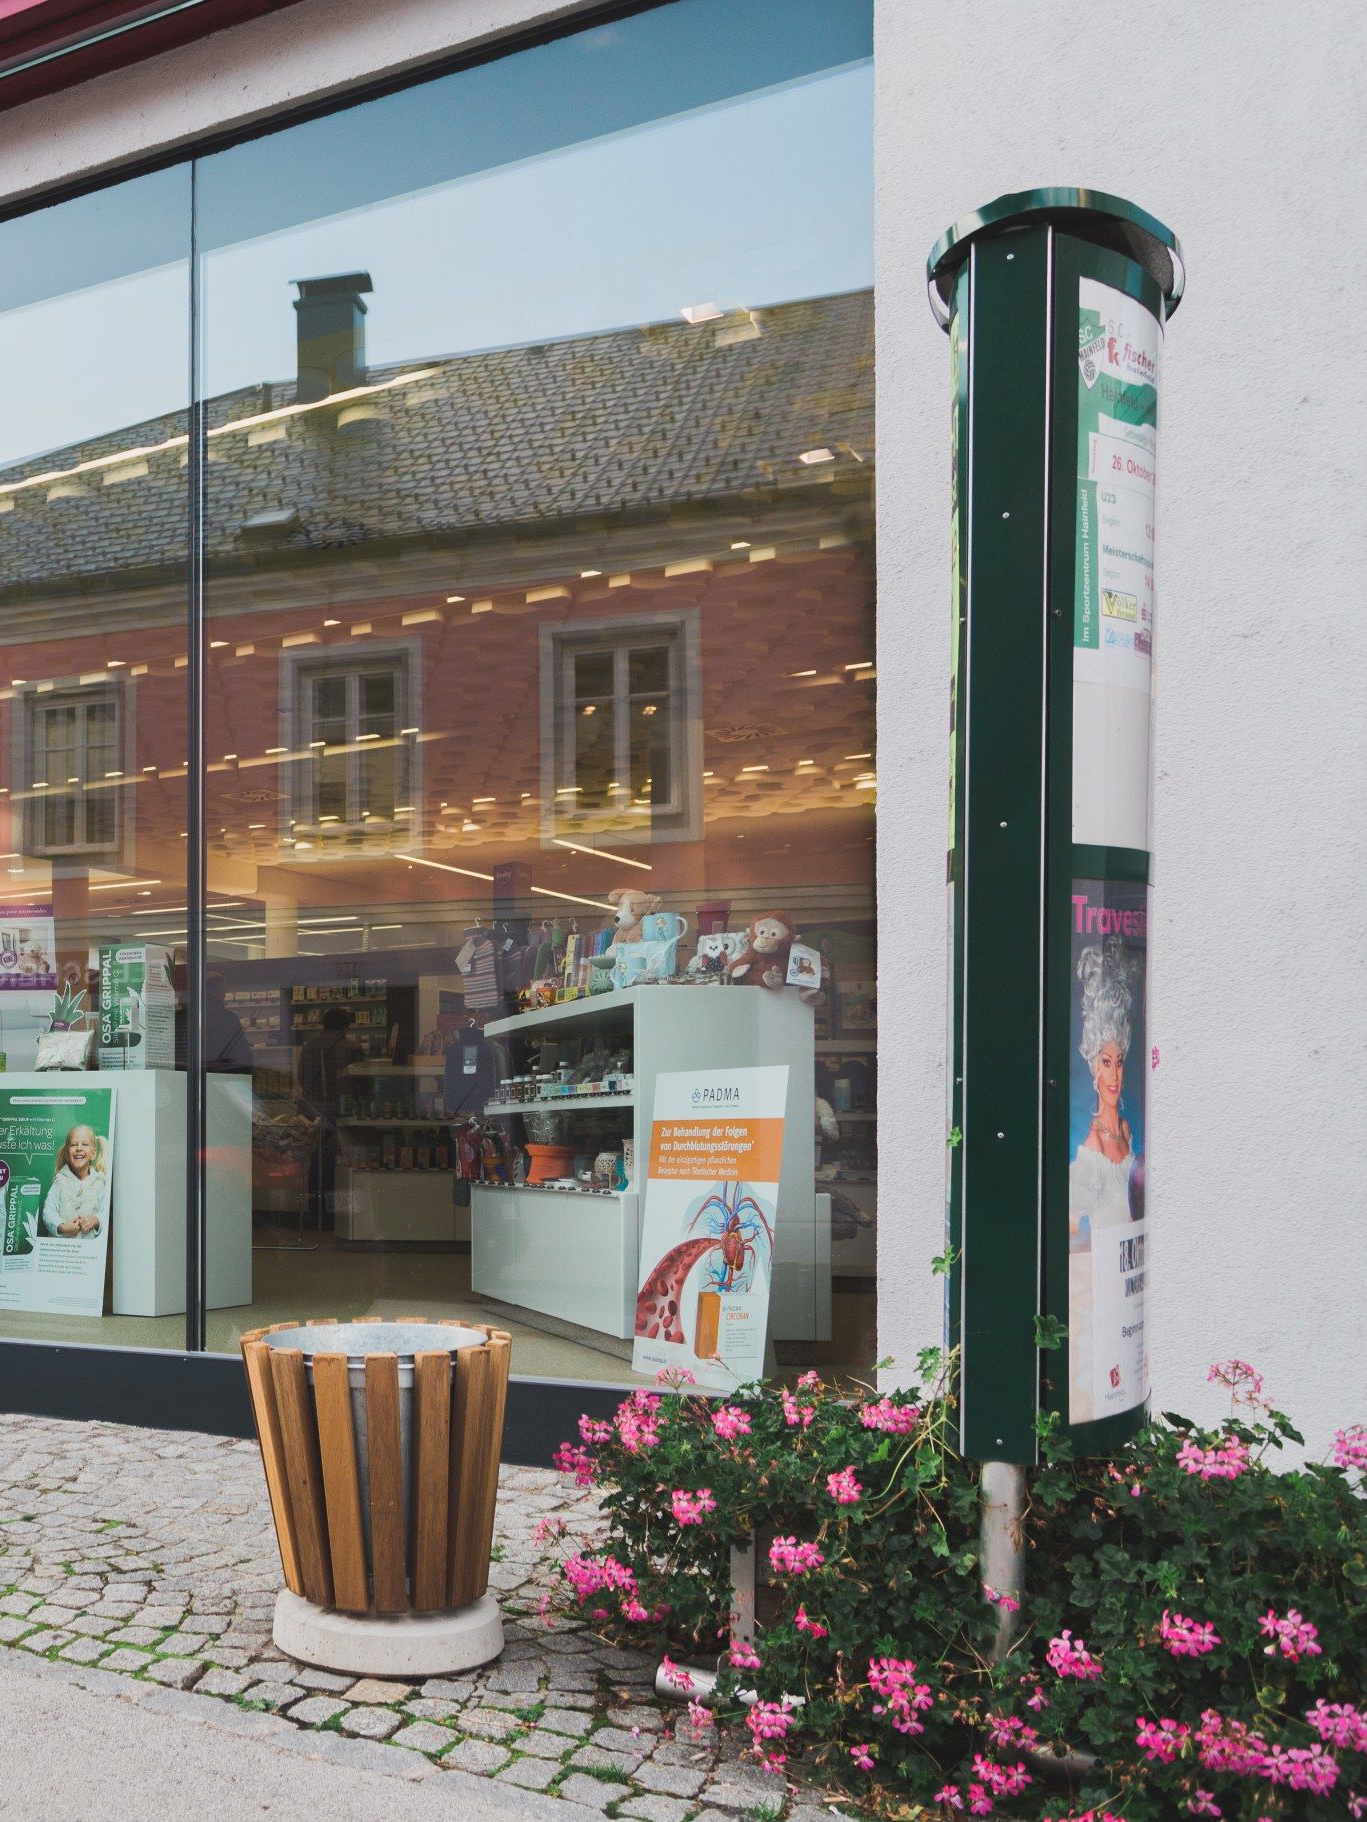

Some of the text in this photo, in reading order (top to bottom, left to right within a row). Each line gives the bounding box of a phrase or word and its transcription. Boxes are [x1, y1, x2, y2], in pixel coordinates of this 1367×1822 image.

[1123, 343, 1155, 373] fischer
[1101, 384, 1138, 409] Hainfeld
[1112, 454, 1124, 471] 26.
[1101, 491, 1116, 504] U23
[1080, 488, 1091, 642] Im Sportzentrum Hainfeld
[101, 949, 112, 1011] GRIPPAL
[703, 1087, 740, 1101] PADMA
[9, 1124, 54, 1139] Erkältung
[661, 1126, 748, 1139] Zur Behandlung der Folgen
[18, 1140, 32, 1150] ich
[33, 1140, 56, 1151] was!
[660, 1143, 672, 1152] von
[659, 1156, 667, 1164] Mit
[667, 1156, 676, 1164] der
[691, 1167, 718, 1176] Tibetischer
[718, 1167, 738, 1176] Medizin
[5, 1184, 19, 1253] OSA GRIPPAL
